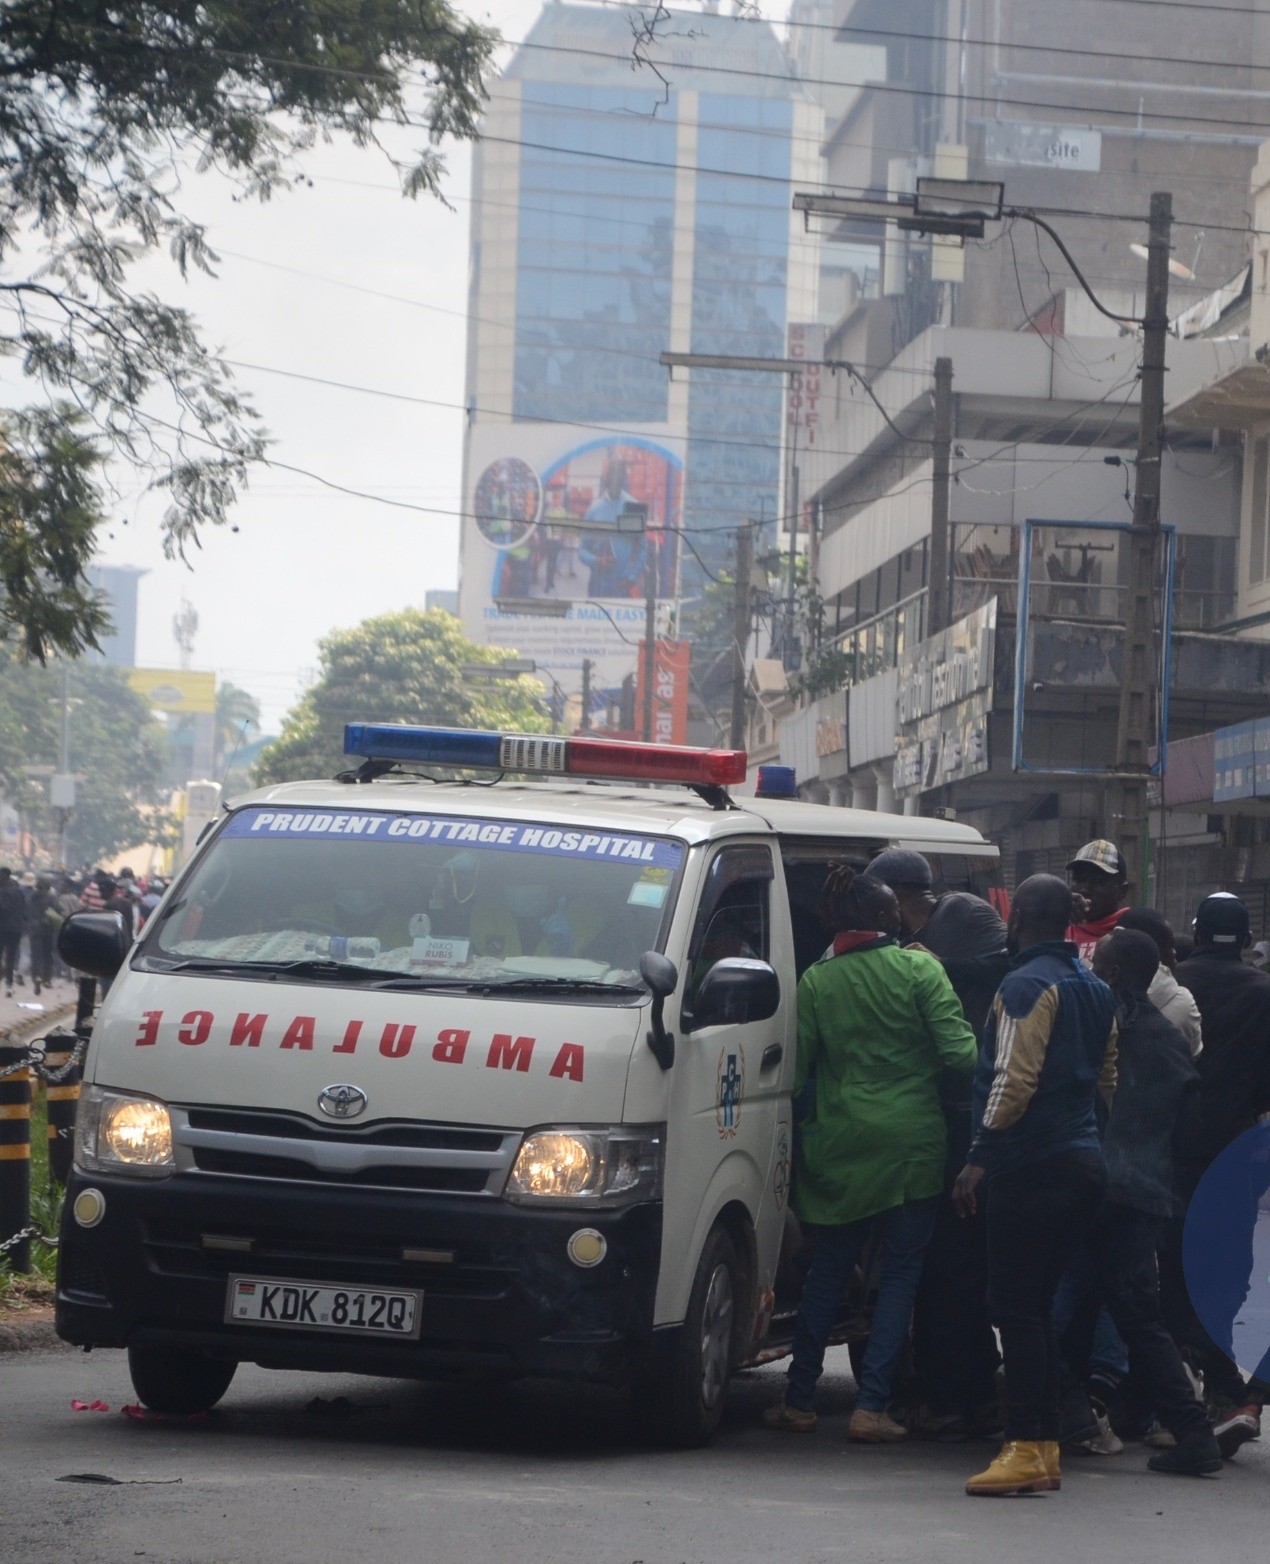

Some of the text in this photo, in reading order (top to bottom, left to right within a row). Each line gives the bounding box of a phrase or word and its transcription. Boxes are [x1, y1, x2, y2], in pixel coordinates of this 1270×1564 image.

[788, 324, 805, 426] SCOOL
[251, 812, 656, 861] PRUDENT COTTAGE HOSPITAL
[260, 1285, 406, 1330] KDK 812Q
